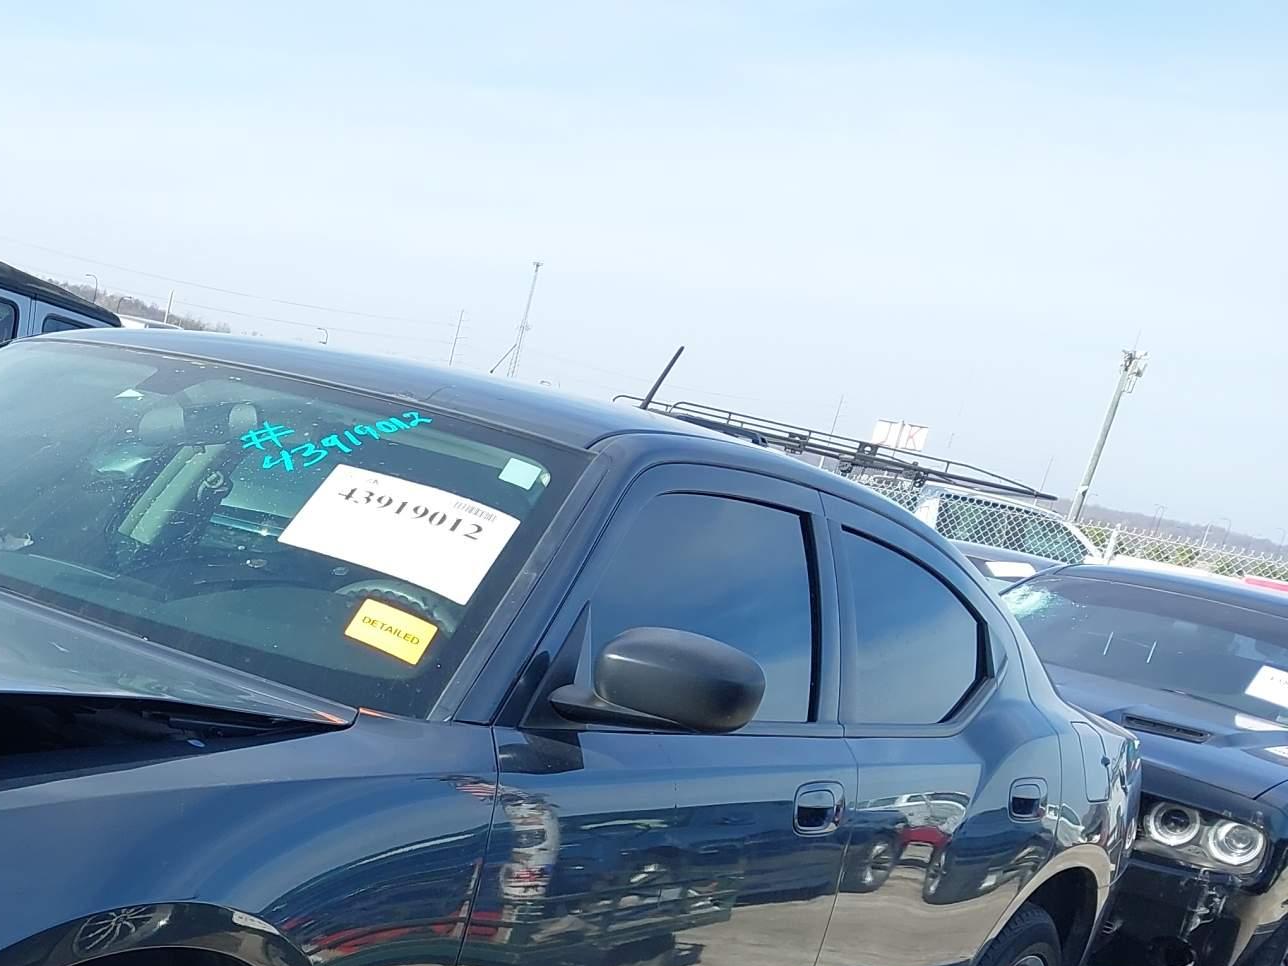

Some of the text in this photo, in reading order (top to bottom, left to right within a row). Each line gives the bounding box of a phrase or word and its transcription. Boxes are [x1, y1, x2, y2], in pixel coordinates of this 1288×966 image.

[262, 411, 433, 472] 43919012
[338, 487, 484, 541] 43919012
[362, 616, 420, 645] DETAILED
